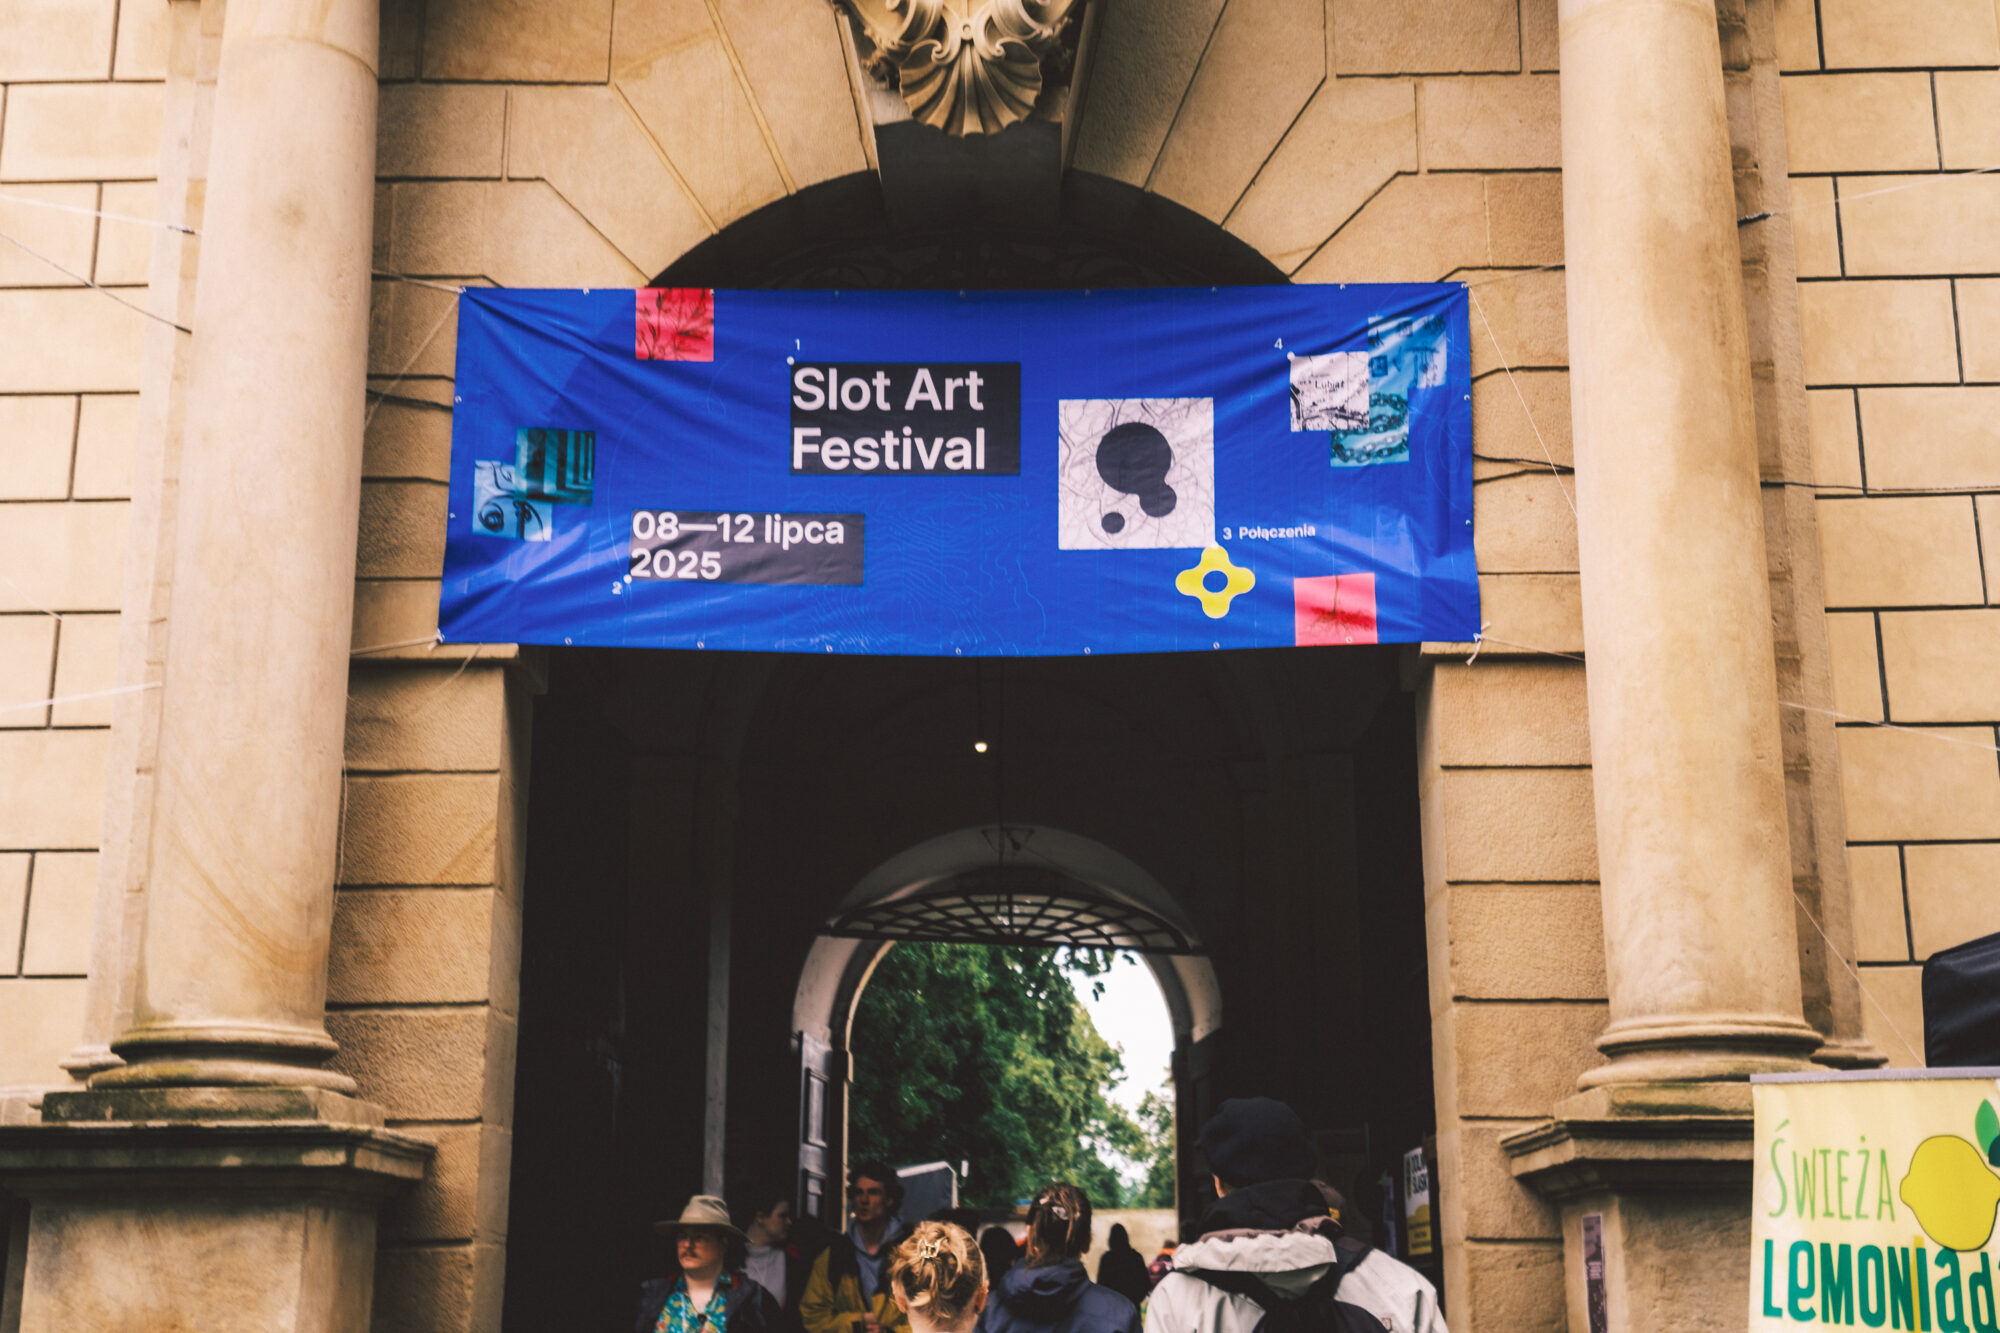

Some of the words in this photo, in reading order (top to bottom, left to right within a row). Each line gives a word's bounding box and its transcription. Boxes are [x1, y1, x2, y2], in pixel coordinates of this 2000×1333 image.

[795, 338, 801, 352] 1
[1274, 337, 1283, 350] 4
[793, 367, 892, 412] Slot
[904, 368, 985, 412] Art
[793, 425, 986, 471] Festival
[764, 513, 845, 551] lipca
[1222, 526, 1233, 541] 3
[1239, 523, 1317, 541] Połączenia
[630, 547, 723, 580] 2025
[612, 580, 623, 596] 2
[1768, 1118, 1896, 1222] ŚWIEŻA
